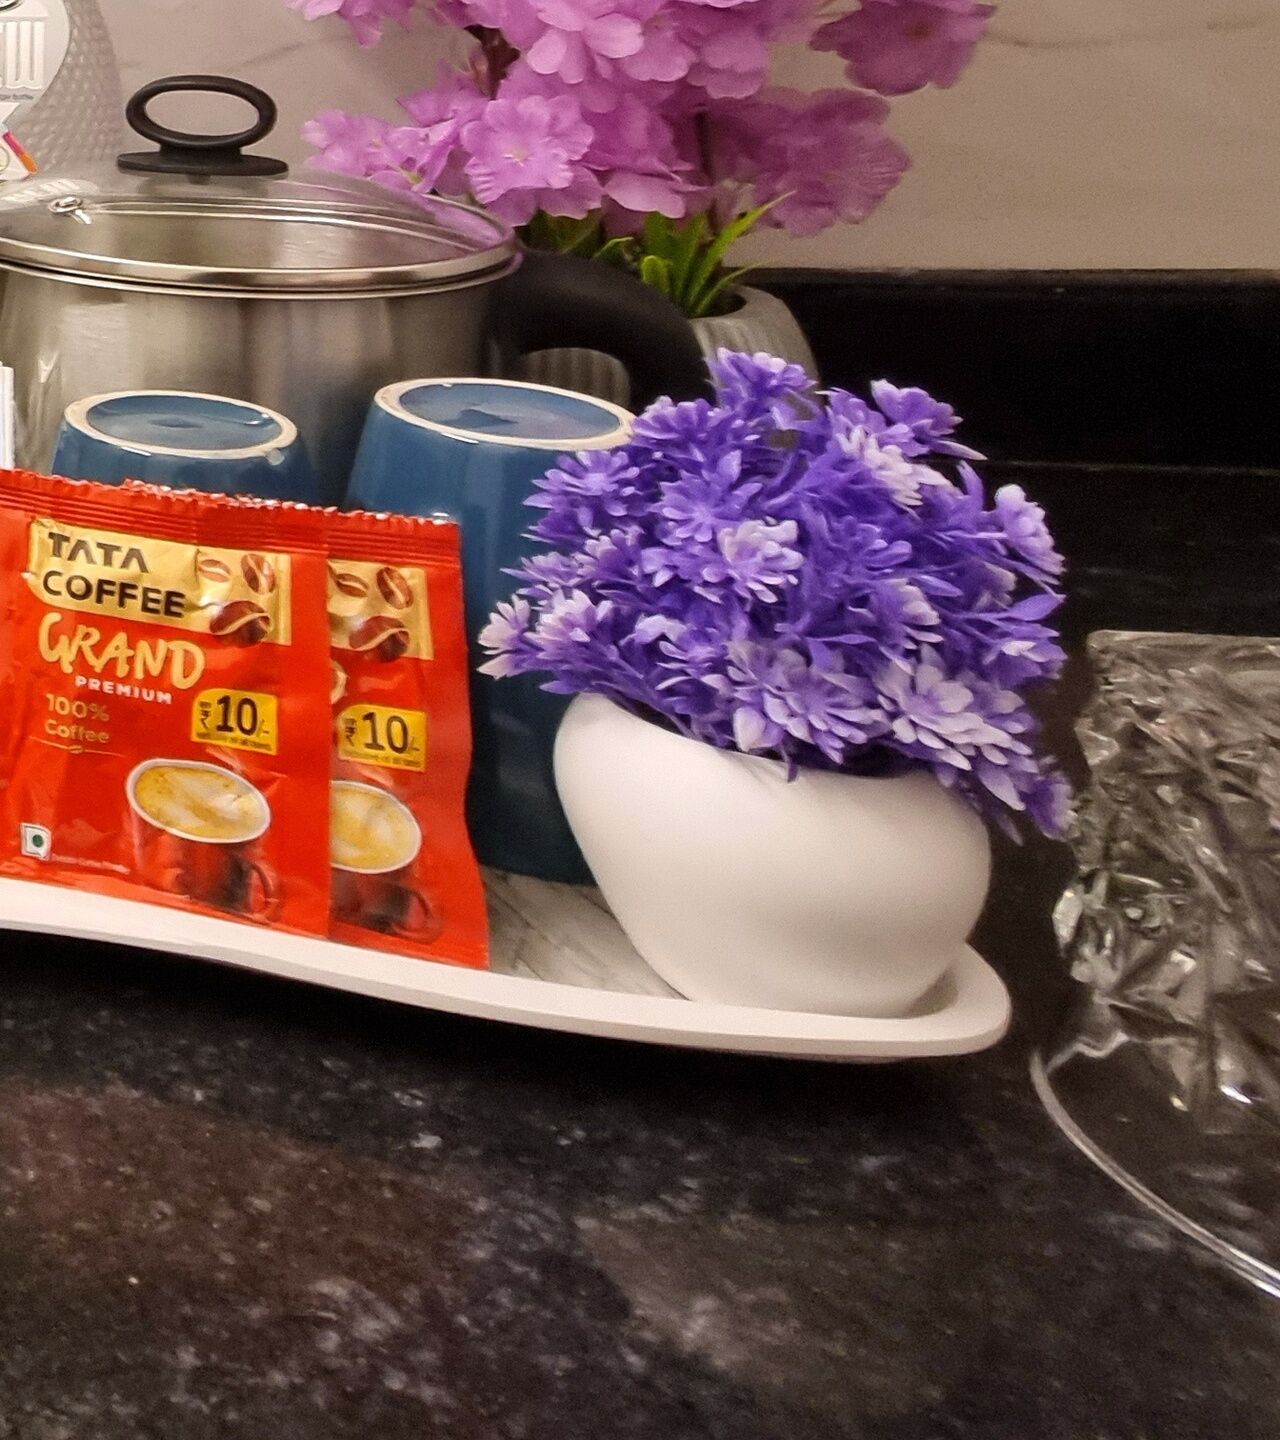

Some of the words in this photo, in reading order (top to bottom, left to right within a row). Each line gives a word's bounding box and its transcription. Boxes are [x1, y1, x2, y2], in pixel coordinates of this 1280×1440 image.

[48, 531, 150, 574] TATA
[42, 569, 186, 619] COFFEE
[38, 612, 206, 690] GRAND
[45, 693, 111, 722] 100%
[74, 675, 173, 705] PREMIUM
[44, 719, 111, 744] Coffee
